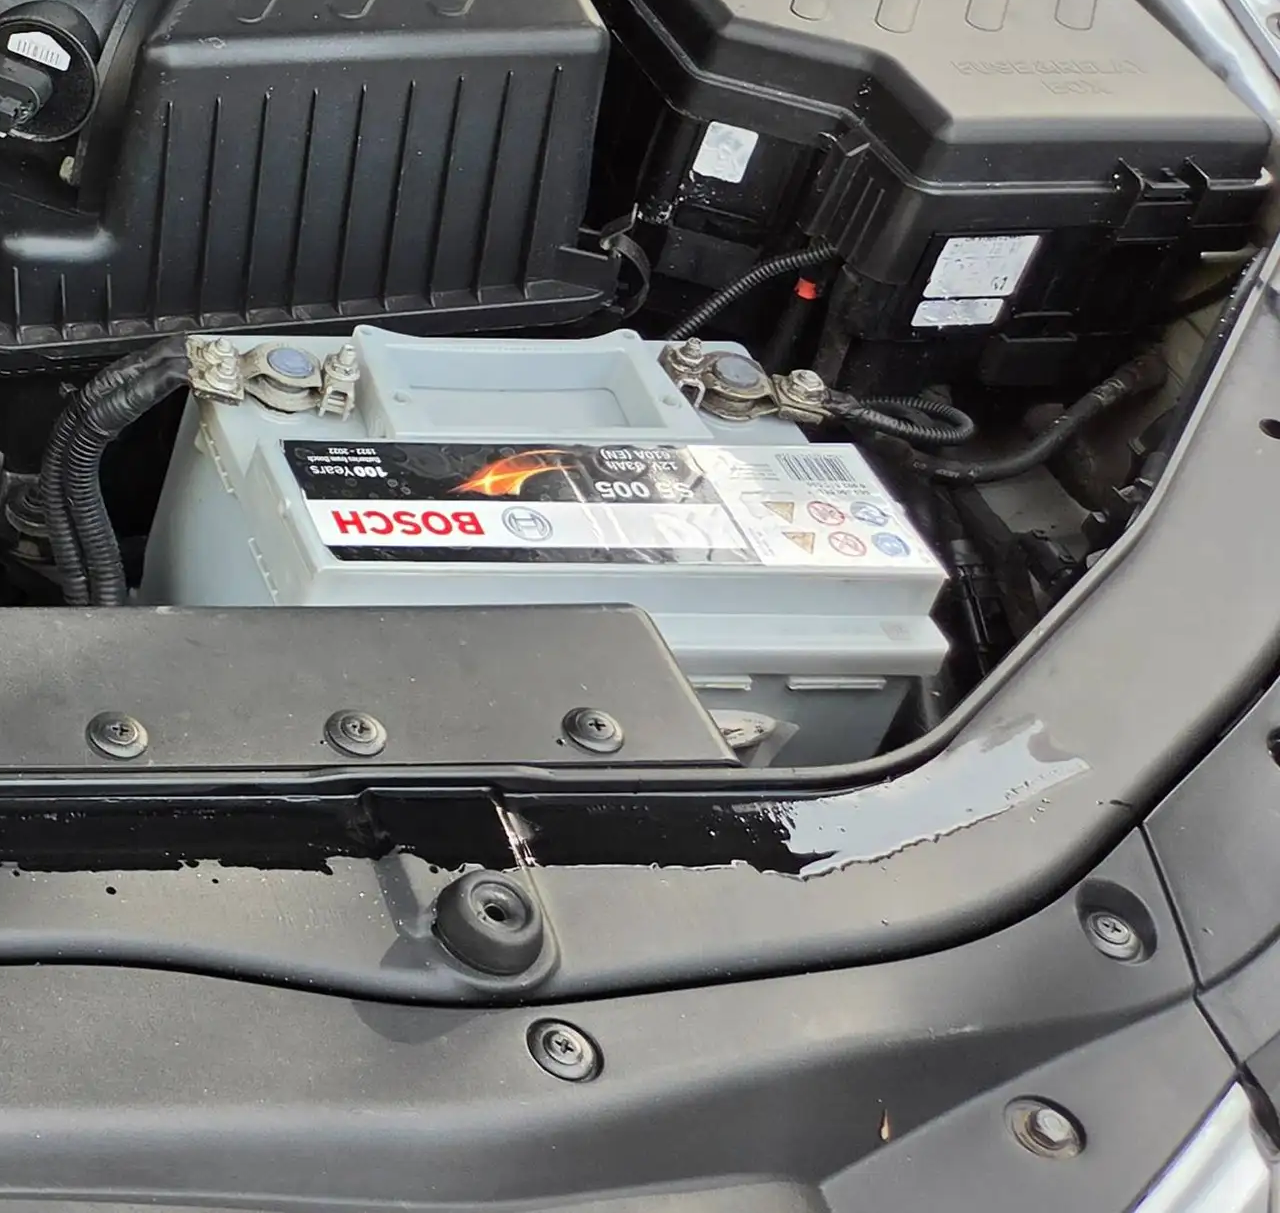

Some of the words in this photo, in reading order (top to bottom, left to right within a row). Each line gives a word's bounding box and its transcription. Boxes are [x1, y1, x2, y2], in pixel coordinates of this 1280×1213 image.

[599, 448, 633, 461] (EN)
[594, 480, 651, 499] 005
[331, 510, 485, 536] BOSCH
